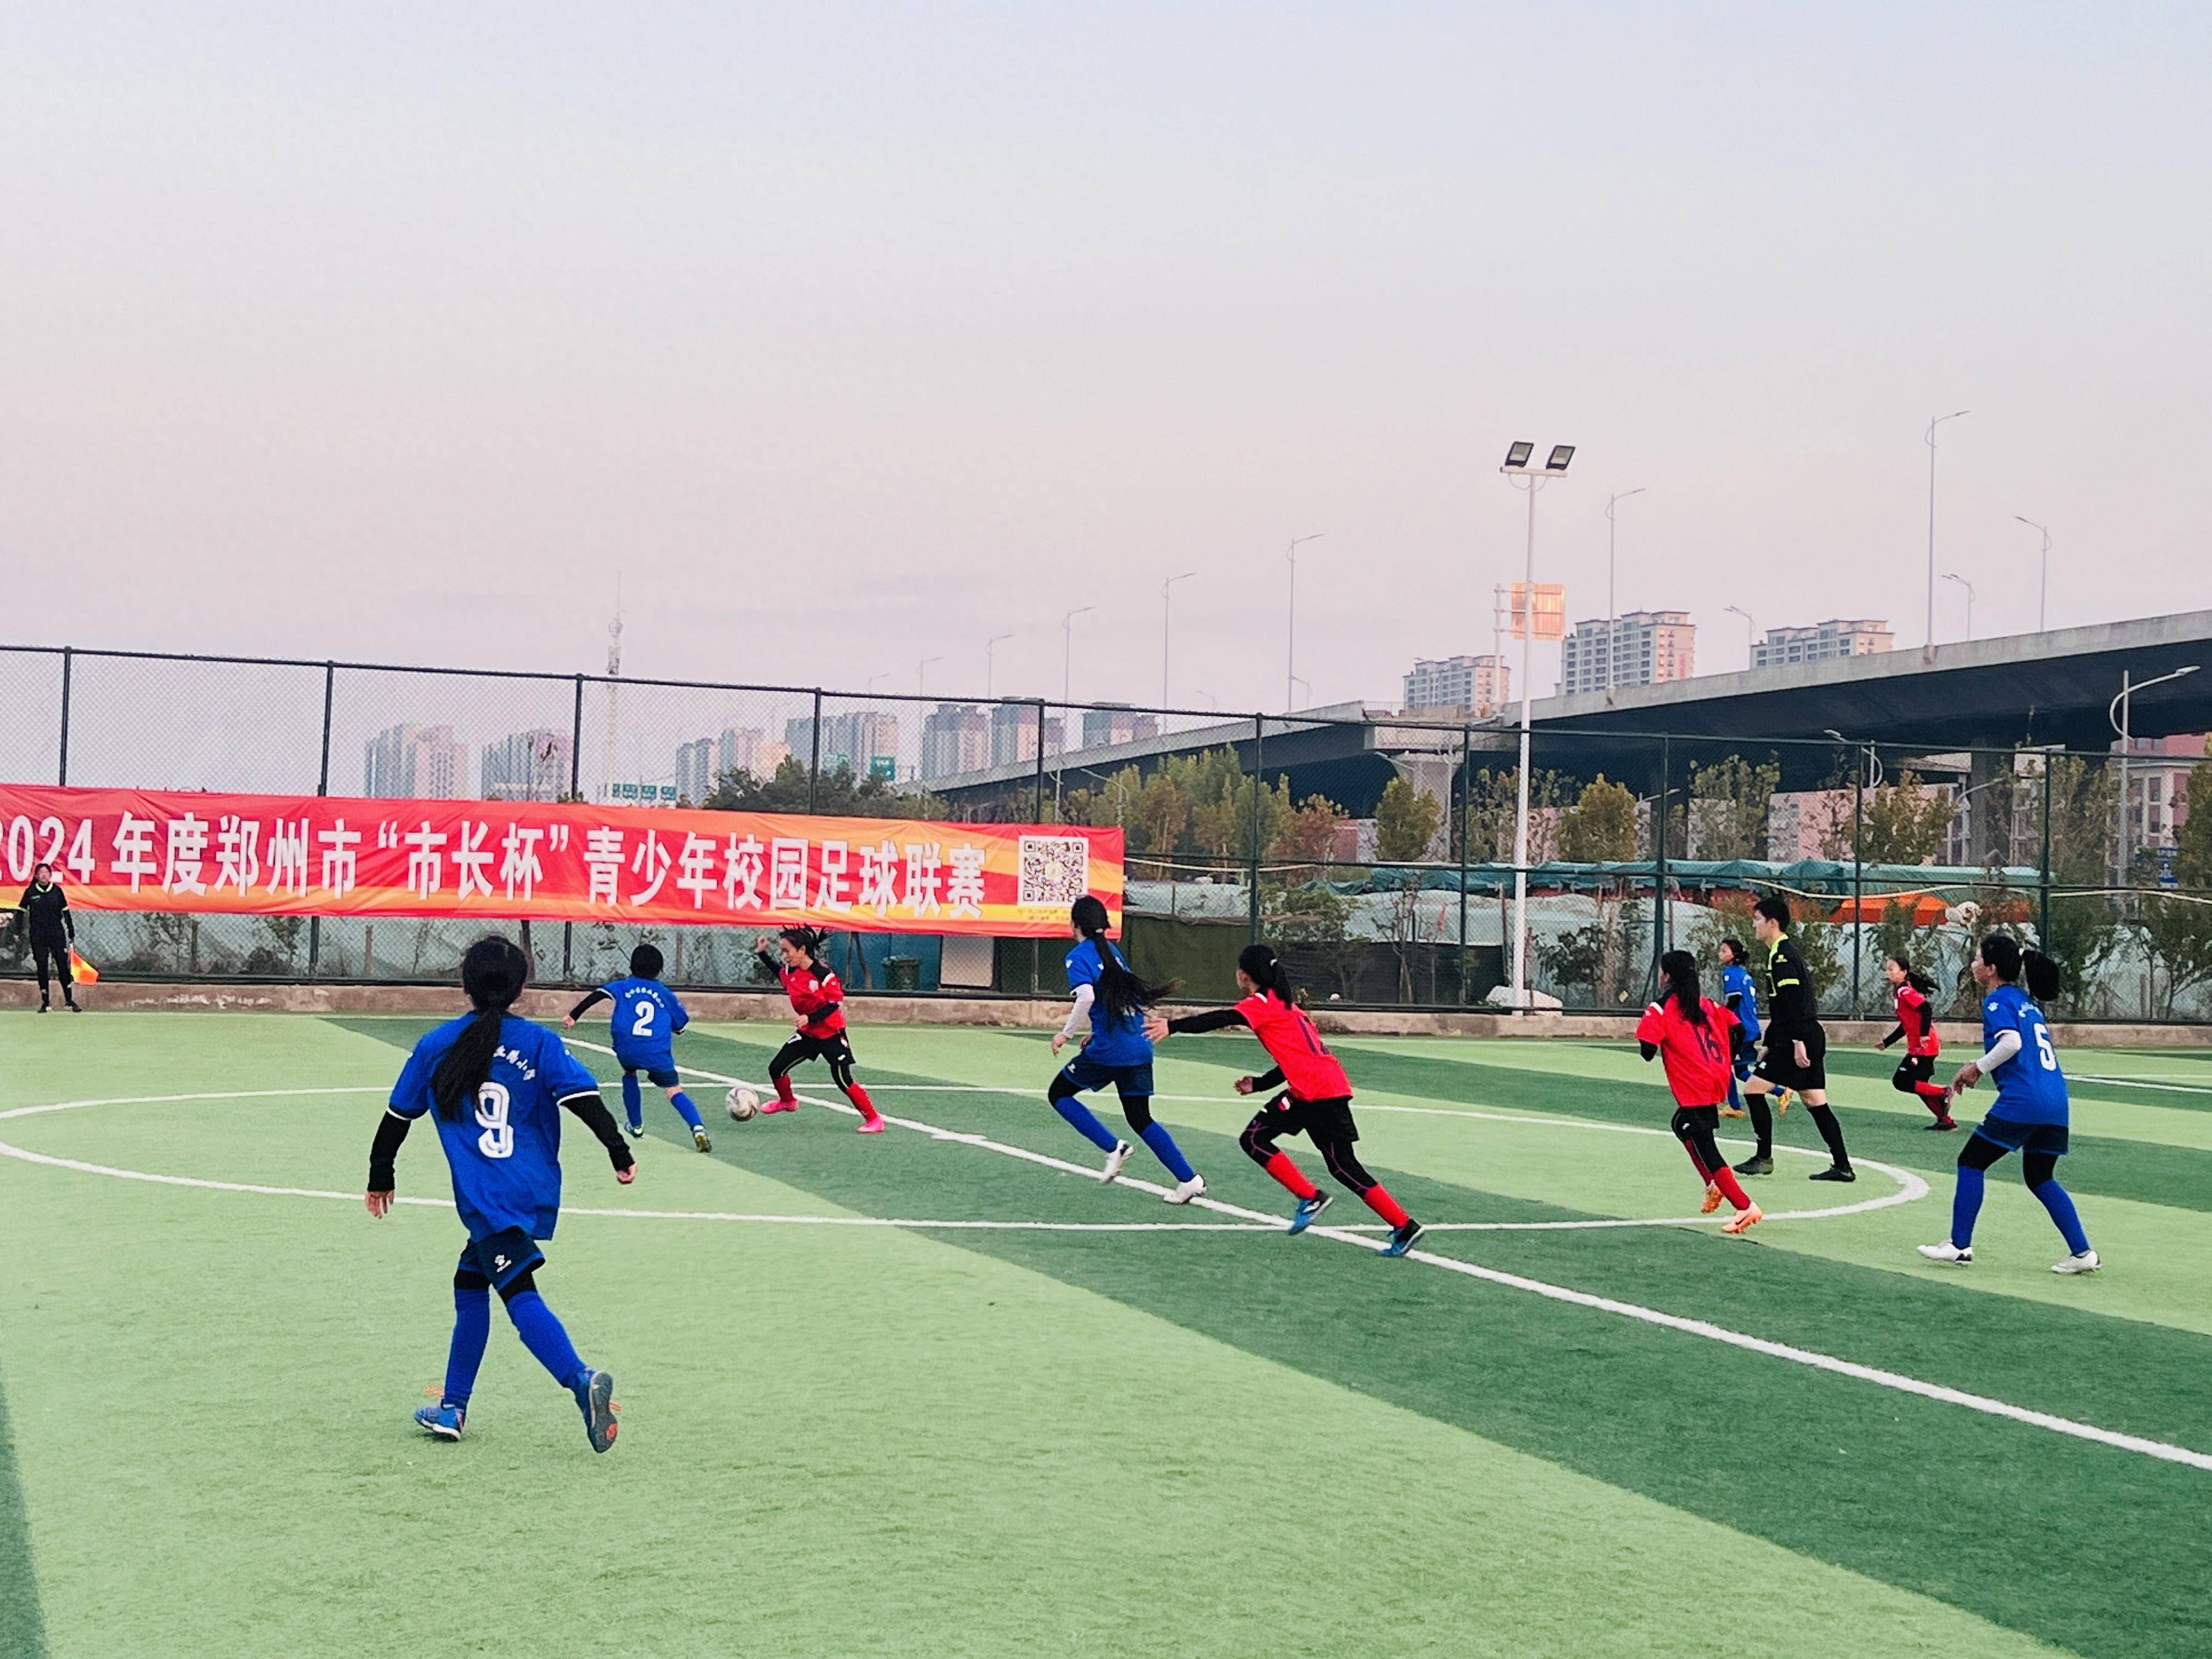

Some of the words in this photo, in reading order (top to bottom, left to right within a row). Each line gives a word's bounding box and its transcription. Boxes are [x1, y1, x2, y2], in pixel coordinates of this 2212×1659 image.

[0, 815, 95, 884] 024
[632, 1000, 654, 1037] 2
[2034, 1023, 2057, 1071] 5
[475, 1081, 514, 1159] 9
